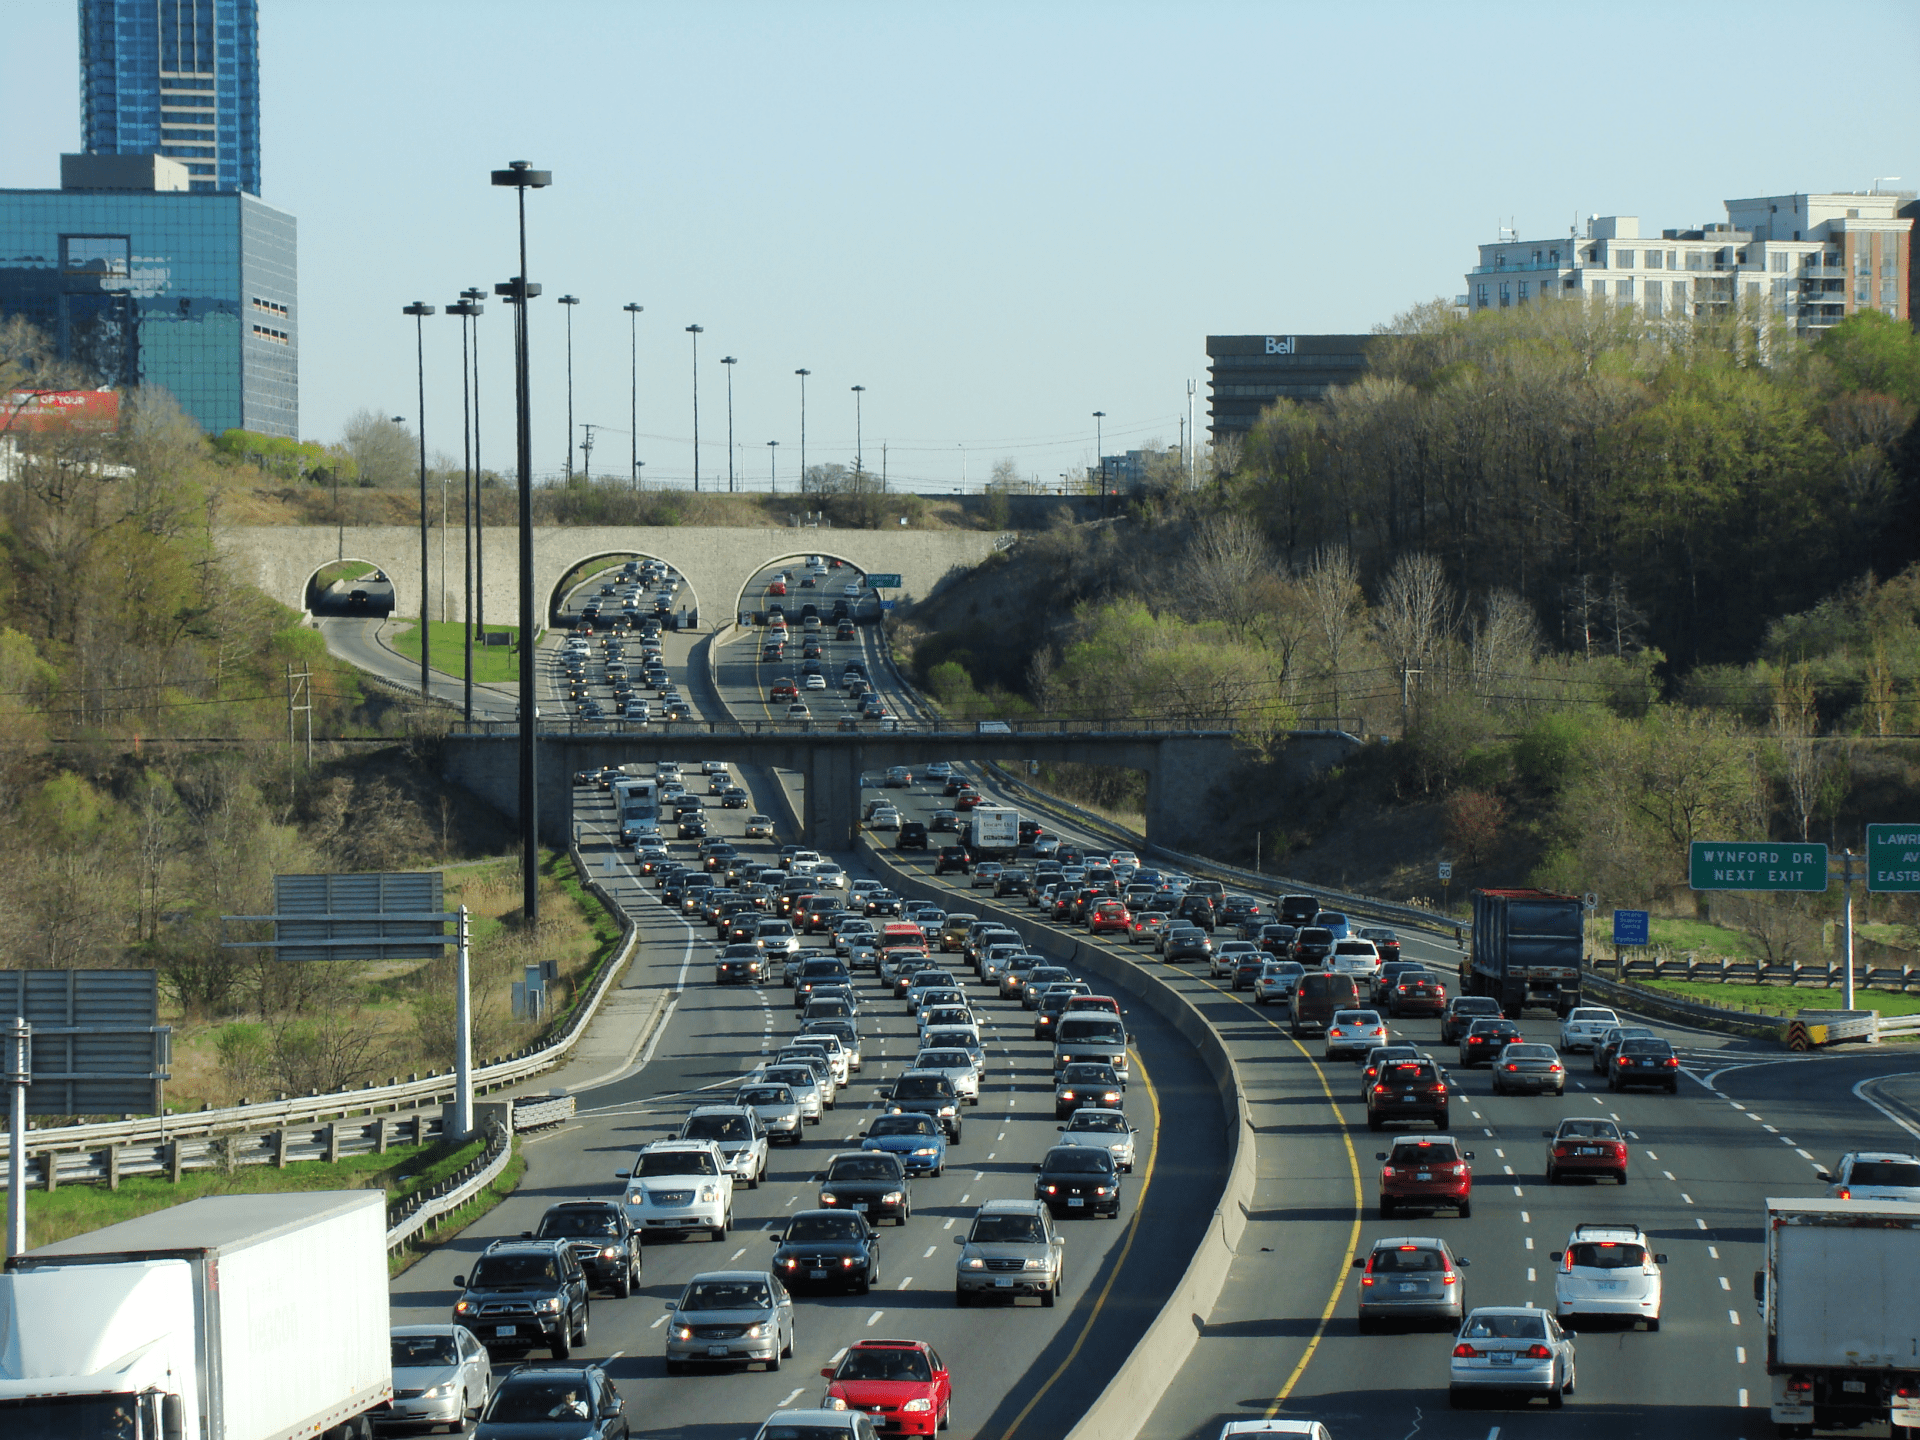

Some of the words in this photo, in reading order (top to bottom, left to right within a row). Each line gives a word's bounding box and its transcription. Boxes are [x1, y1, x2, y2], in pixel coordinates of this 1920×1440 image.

[1265, 336, 1296, 354] Bell
[40, 395, 55, 404] OF
[57, 395, 85, 405] YOUR
[1703, 850, 1780, 864] WYNFORD
[1792, 852, 1817, 865] DR.
[1440, 868, 1451, 878] 90
[1714, 869, 1755, 881] NEXT
[1768, 870, 1804, 882] EXIT
